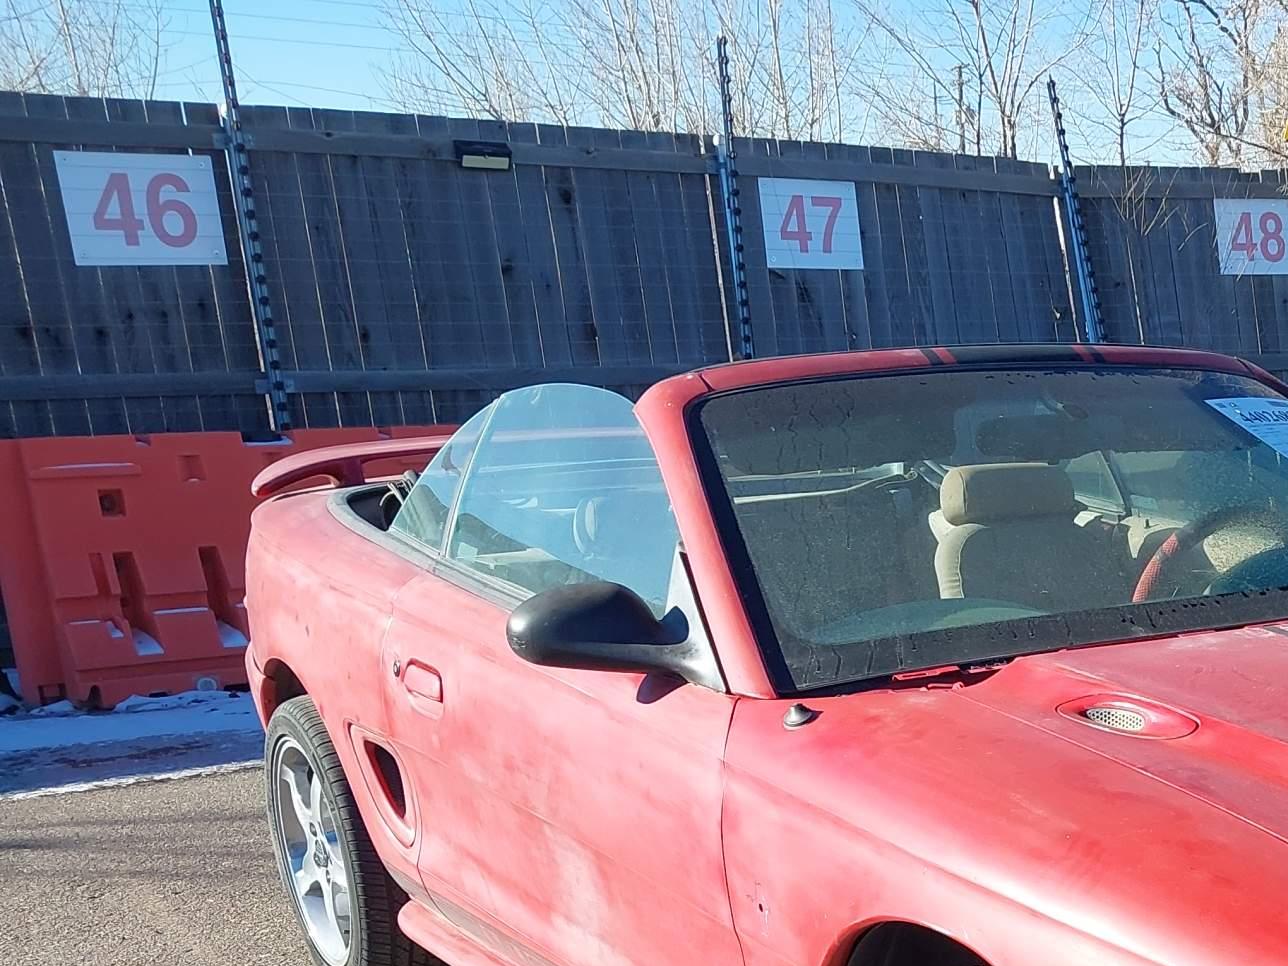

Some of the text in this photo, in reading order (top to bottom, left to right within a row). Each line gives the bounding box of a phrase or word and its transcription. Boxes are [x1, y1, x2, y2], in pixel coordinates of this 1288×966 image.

[93, 172, 198, 248] 46
[780, 194, 842, 254] 47
[1231, 211, 1286, 263] 48
